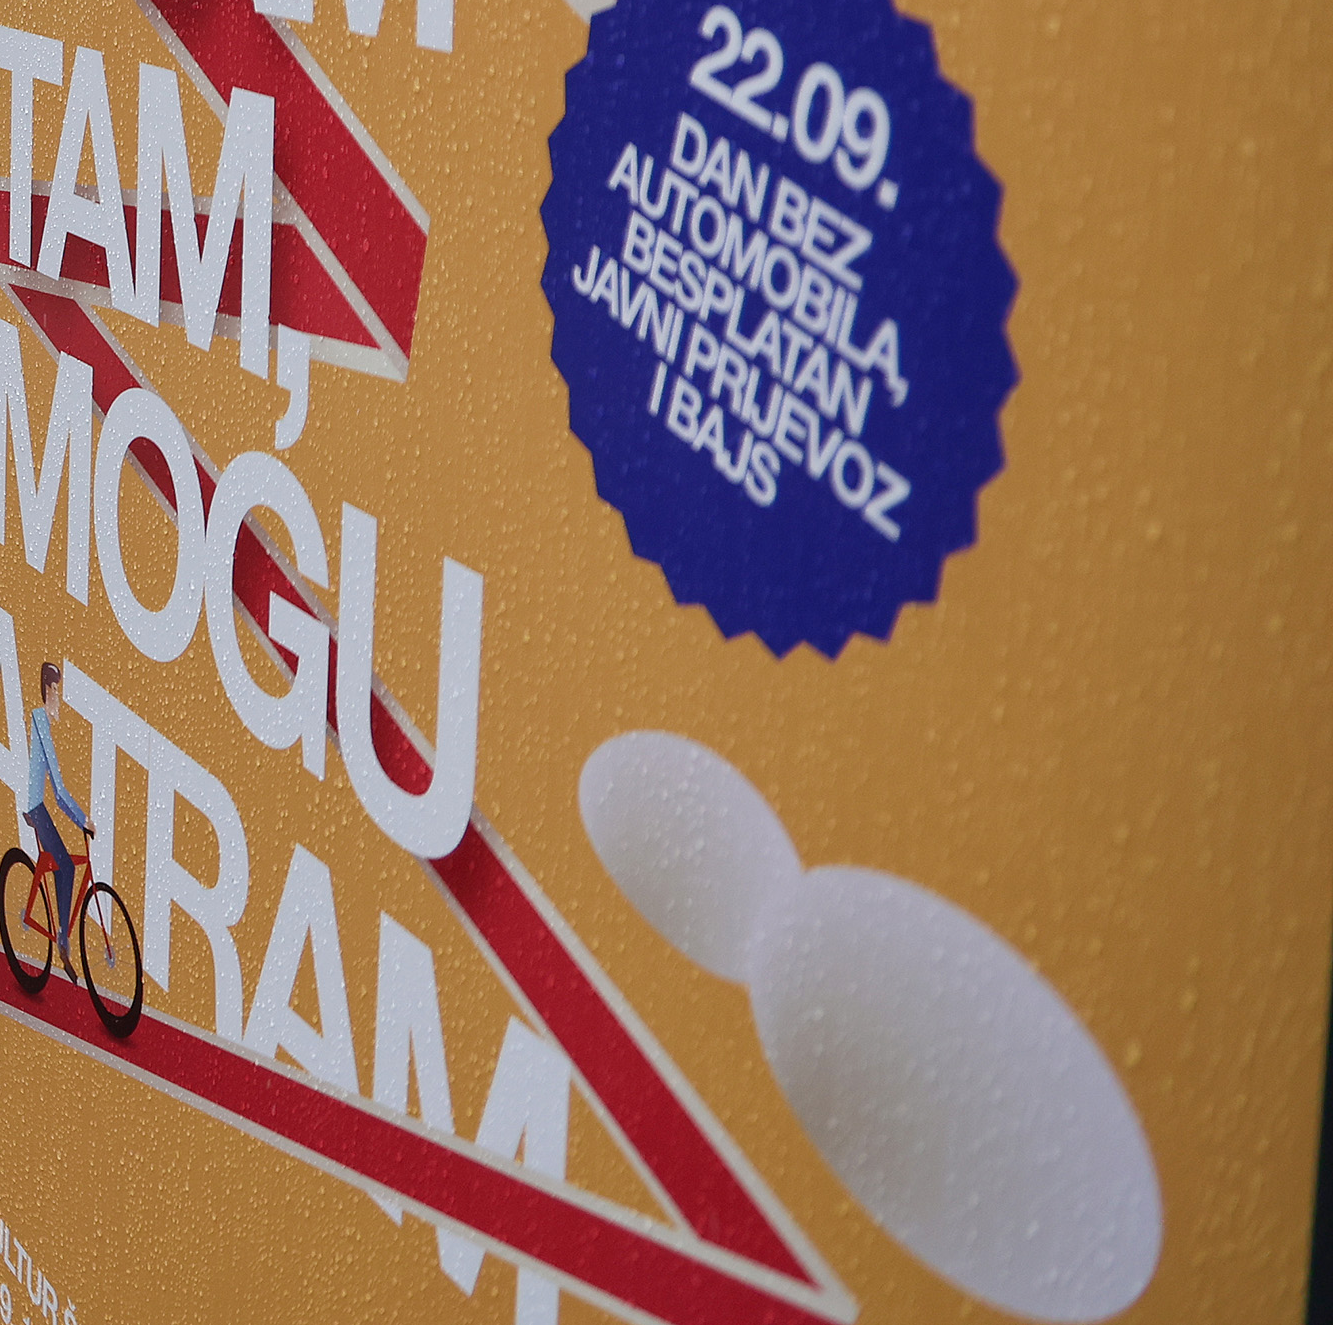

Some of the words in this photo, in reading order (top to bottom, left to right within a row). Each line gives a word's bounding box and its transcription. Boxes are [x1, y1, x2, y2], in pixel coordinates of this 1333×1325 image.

[670, 112, 770, 225] DAN
[769, 176, 873, 292] BEZ
[689, 4, 899, 211] 22.09.
[608, 141, 910, 408] AUTOMOBILA,
[623, 217, 873, 438] BESPLATAN
[571, 244, 686, 364] JAVNI
[685, 322, 912, 542] PRIJEVOZ
[647, 362, 667, 417] I
[666, 375, 782, 507] BAJS
[62, 658, 572, 1325] TRAM
